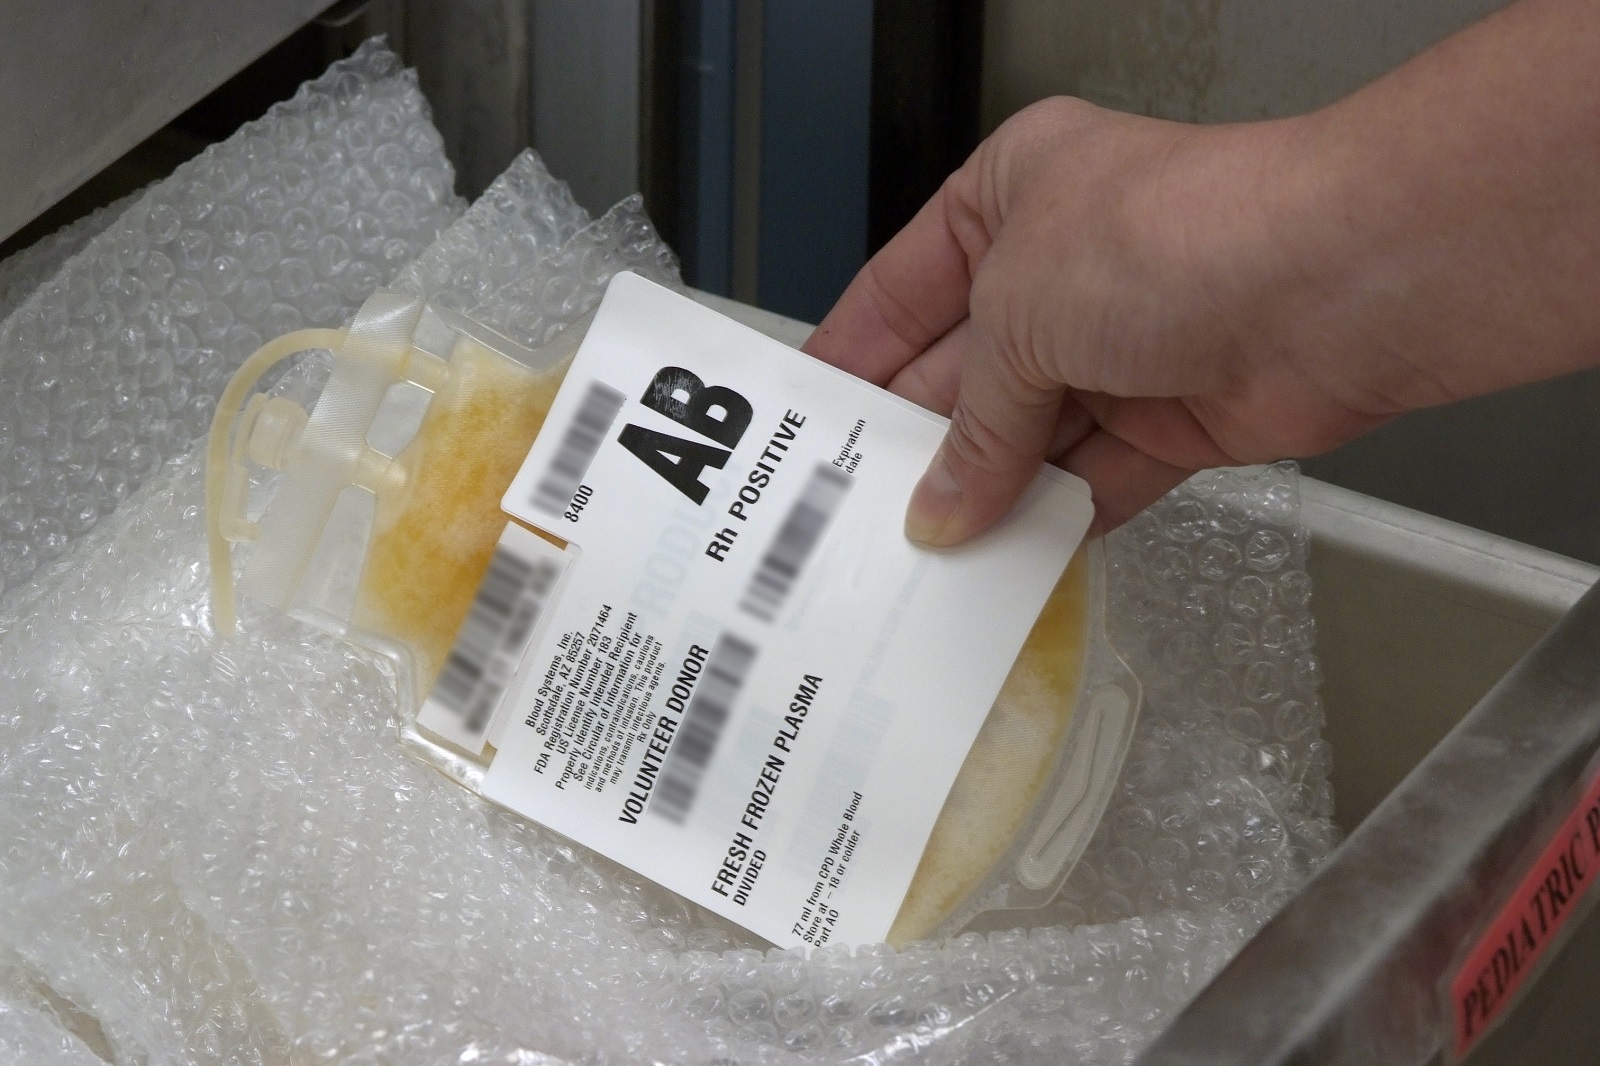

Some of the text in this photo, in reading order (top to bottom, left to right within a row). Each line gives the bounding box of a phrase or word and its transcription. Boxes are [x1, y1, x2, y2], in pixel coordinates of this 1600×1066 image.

[616, 365, 754, 507] AB
[704, 527, 738, 563] Rh
[727, 408, 807, 522] POSITIVE
[832, 419, 866, 468] Expiration
[845, 452, 863, 474] date
[563, 484, 594, 523] 8400
[524, 632, 573, 728] Blood Systems, Inc.
[533, 604, 612, 775] FDA Registration Number 2071464
[535, 631, 586, 736] Scottsdale, AZ 85257
[554, 612, 638, 790] Properly Identify Intended Recipient
[555, 635, 612, 755] US License Number 183
[573, 632, 642, 782] See Circular of Information for
[583, 634, 654, 790] indications, contraindications, cautions
[595, 641, 663, 793] and methods of infusion. This product
[609, 662, 666, 785] may transmit infectious agents.
[618, 644, 709, 825] VOLUNTEER DONOR
[636, 710, 657, 743] Rx Only
[710, 832, 753, 897] FRESH
[741, 754, 786, 831] FROZEN
[773, 674, 823, 753] PLASMA
[732, 849, 767, 907] DIVIDED
[791, 791, 863, 936] 77 ml from CPD Whole Blood
[802, 916, 822, 943] Store
[818, 902, 829, 915] at
[836, 863, 846, 876] or
[842, 830, 860, 863] colder
[813, 926, 832, 948] Part
[1462, 831, 1585, 1040] PEDIATRIC
